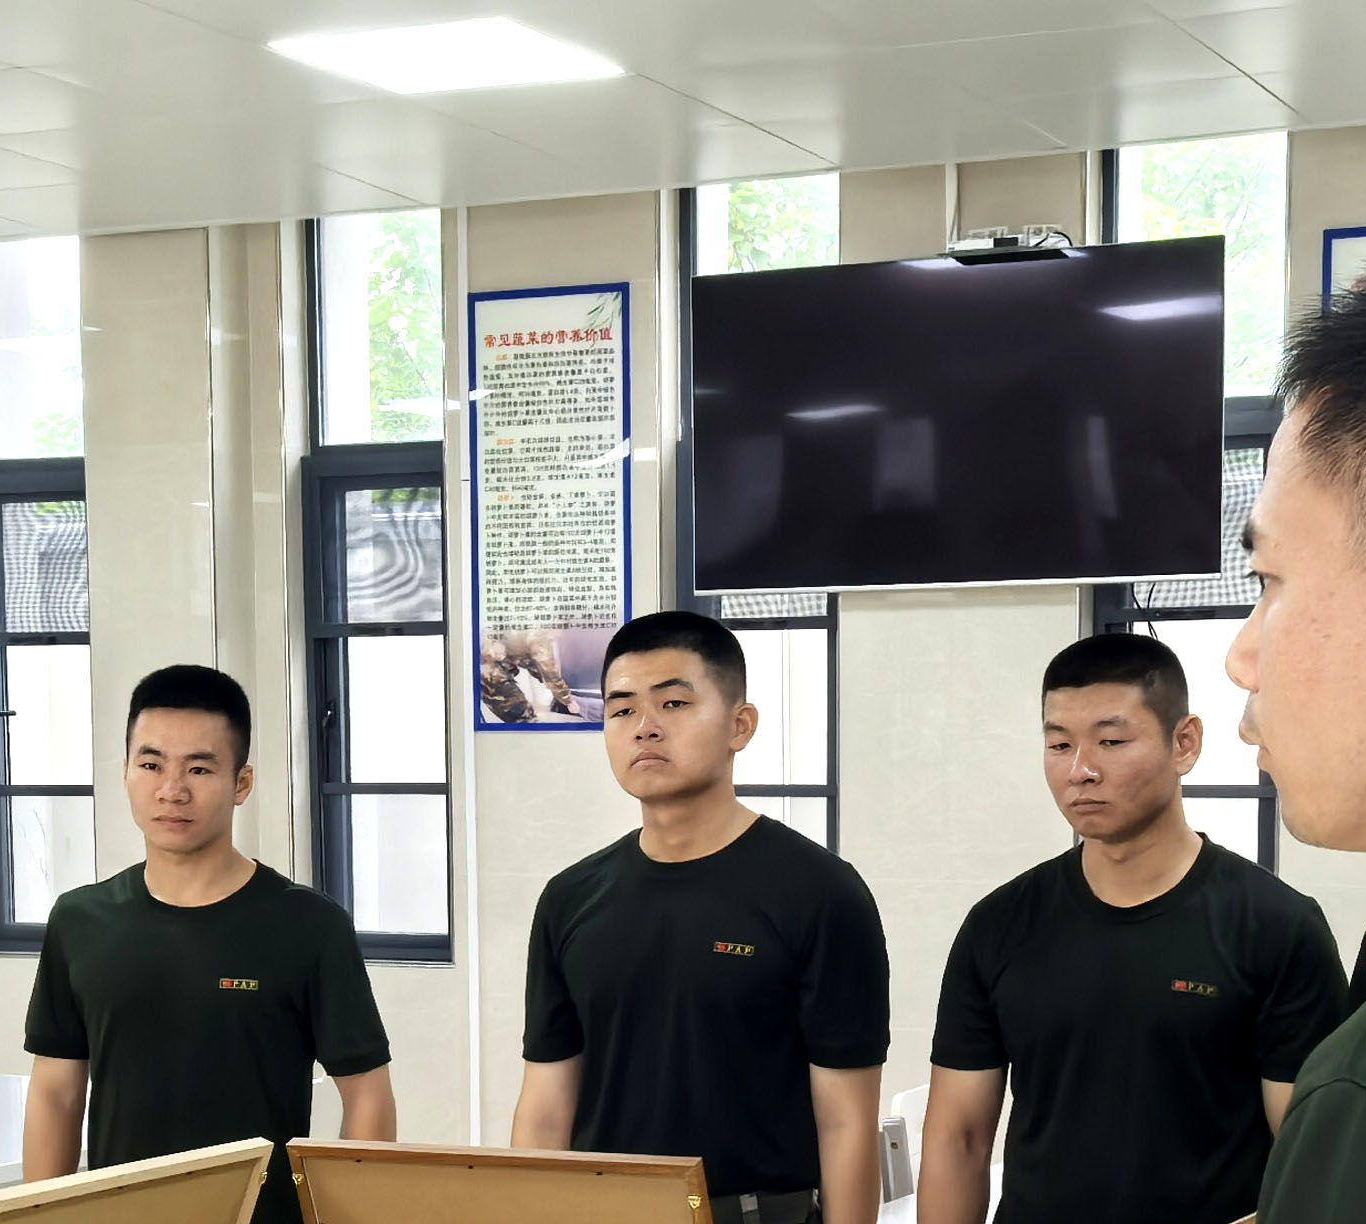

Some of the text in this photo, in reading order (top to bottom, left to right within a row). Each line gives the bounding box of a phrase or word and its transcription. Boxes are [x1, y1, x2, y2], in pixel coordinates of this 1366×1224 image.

[484, 327, 612, 348] 常见蔬菜的营养价值
